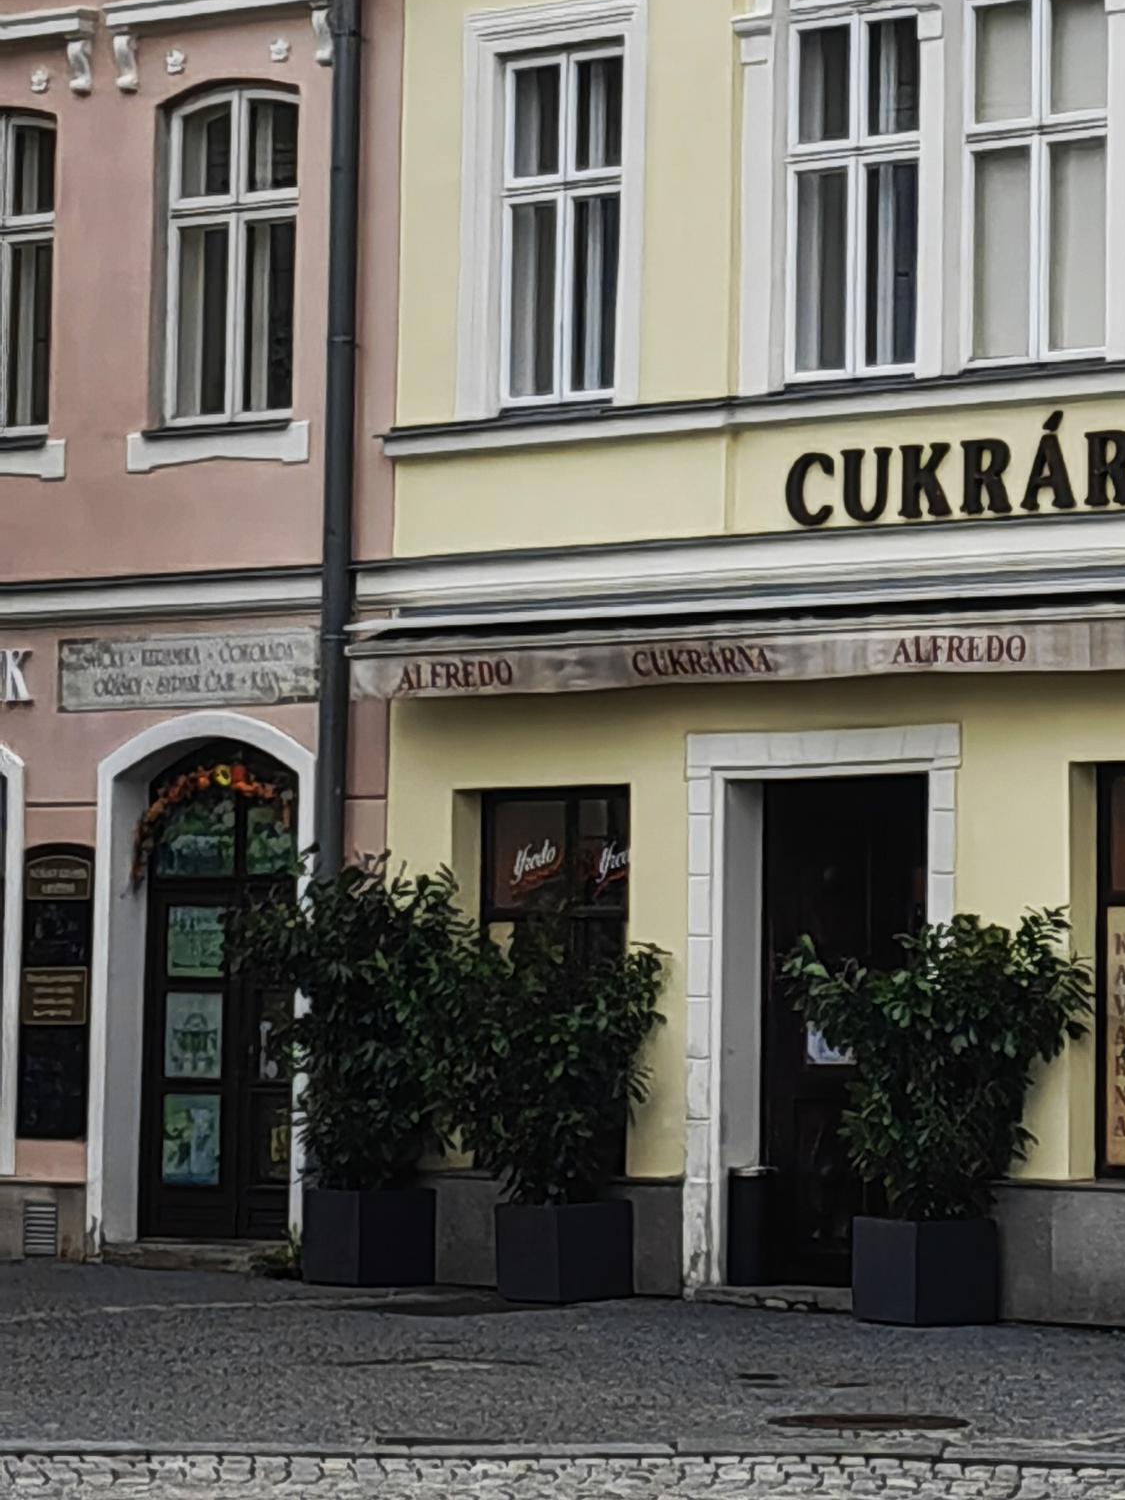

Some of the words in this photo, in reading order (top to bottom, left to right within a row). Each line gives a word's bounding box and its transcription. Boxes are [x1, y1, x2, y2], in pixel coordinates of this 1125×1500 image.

[1, 650, 33, 702] K
[397, 659, 513, 691] ALFREDO
[632, 641, 773, 677] CUKRÁRNA
[889, 634, 1026, 664] ALFREDO
